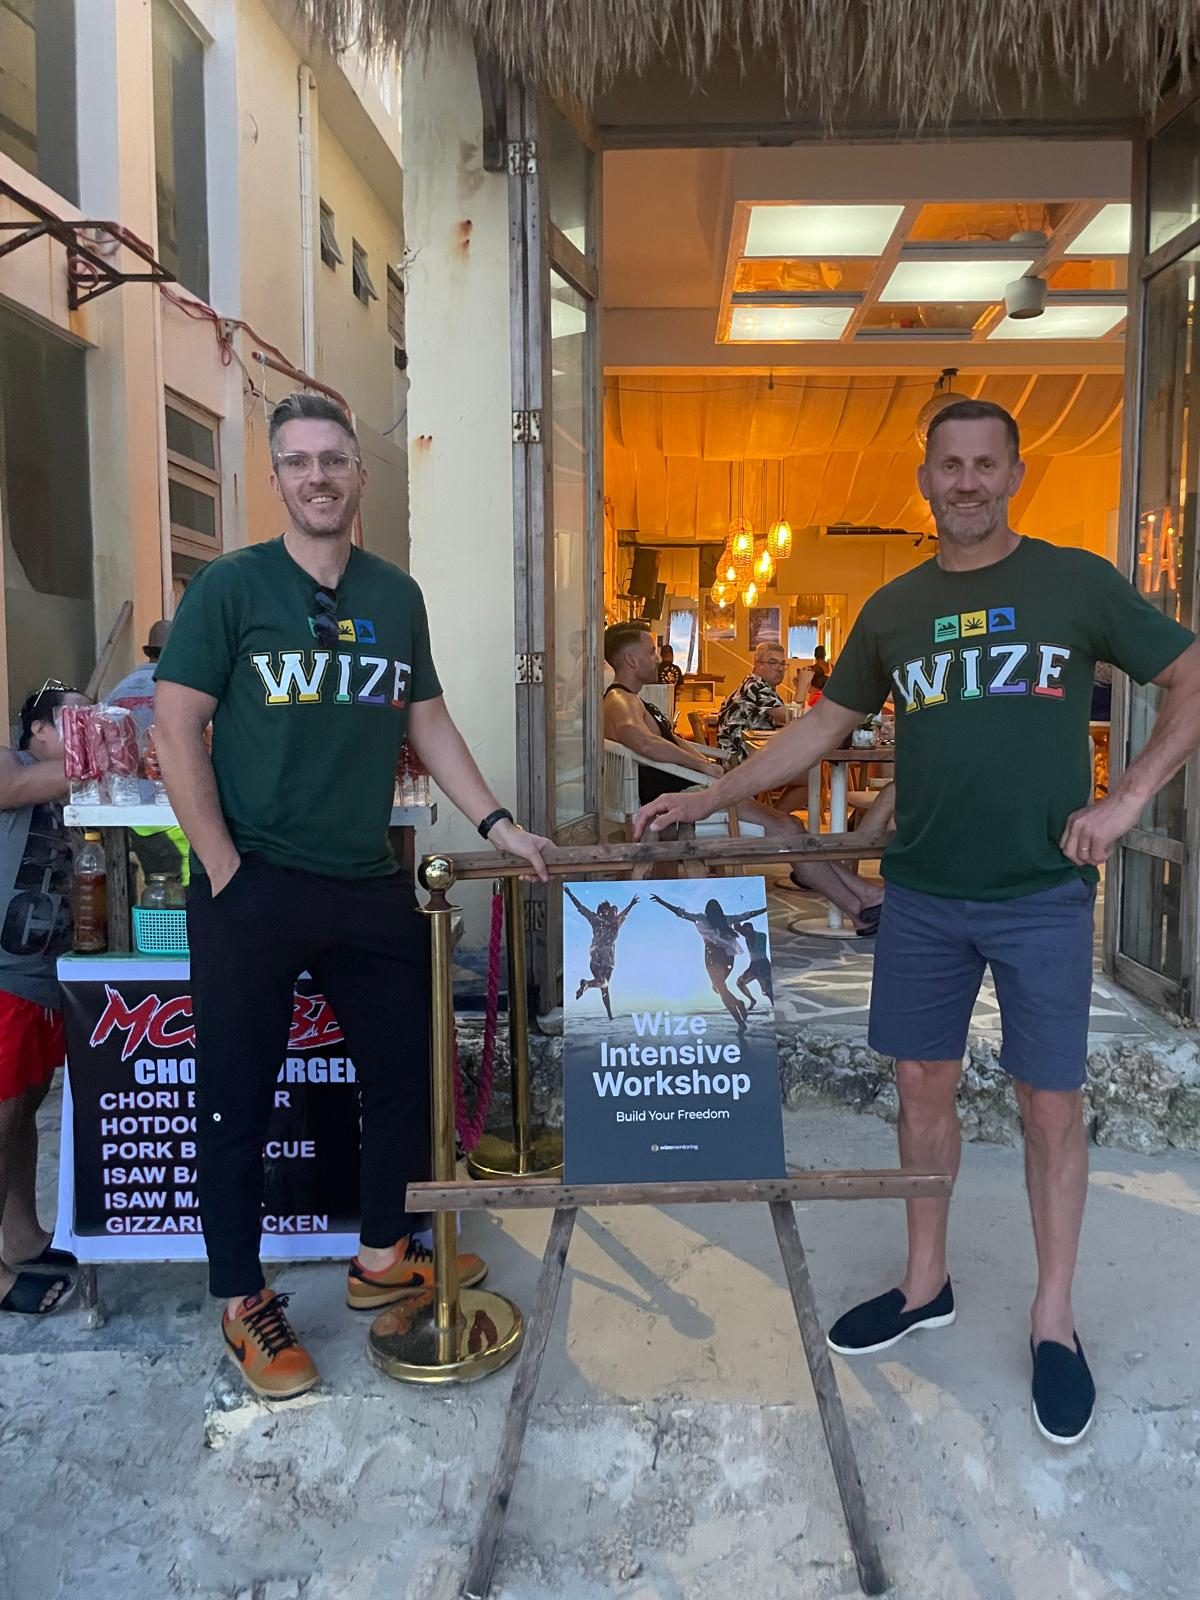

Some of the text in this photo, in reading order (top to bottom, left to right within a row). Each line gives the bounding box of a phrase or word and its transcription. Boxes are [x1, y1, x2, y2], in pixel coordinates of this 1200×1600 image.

[250, 650, 412, 709] WIZE
[892, 643, 1071, 713] WIZE
[631, 1011, 708, 1037] Wize
[600, 1038, 742, 1067] Intensive
[592, 1069, 751, 1100] Workshop
[99, 1091, 179, 1110] CHORI
[616, 1108, 730, 1122] Build Your Freedom
[102, 1141, 174, 1160] PORK
[103, 1166, 166, 1185] ISAW
[104, 1191, 167, 1210] ISAW
